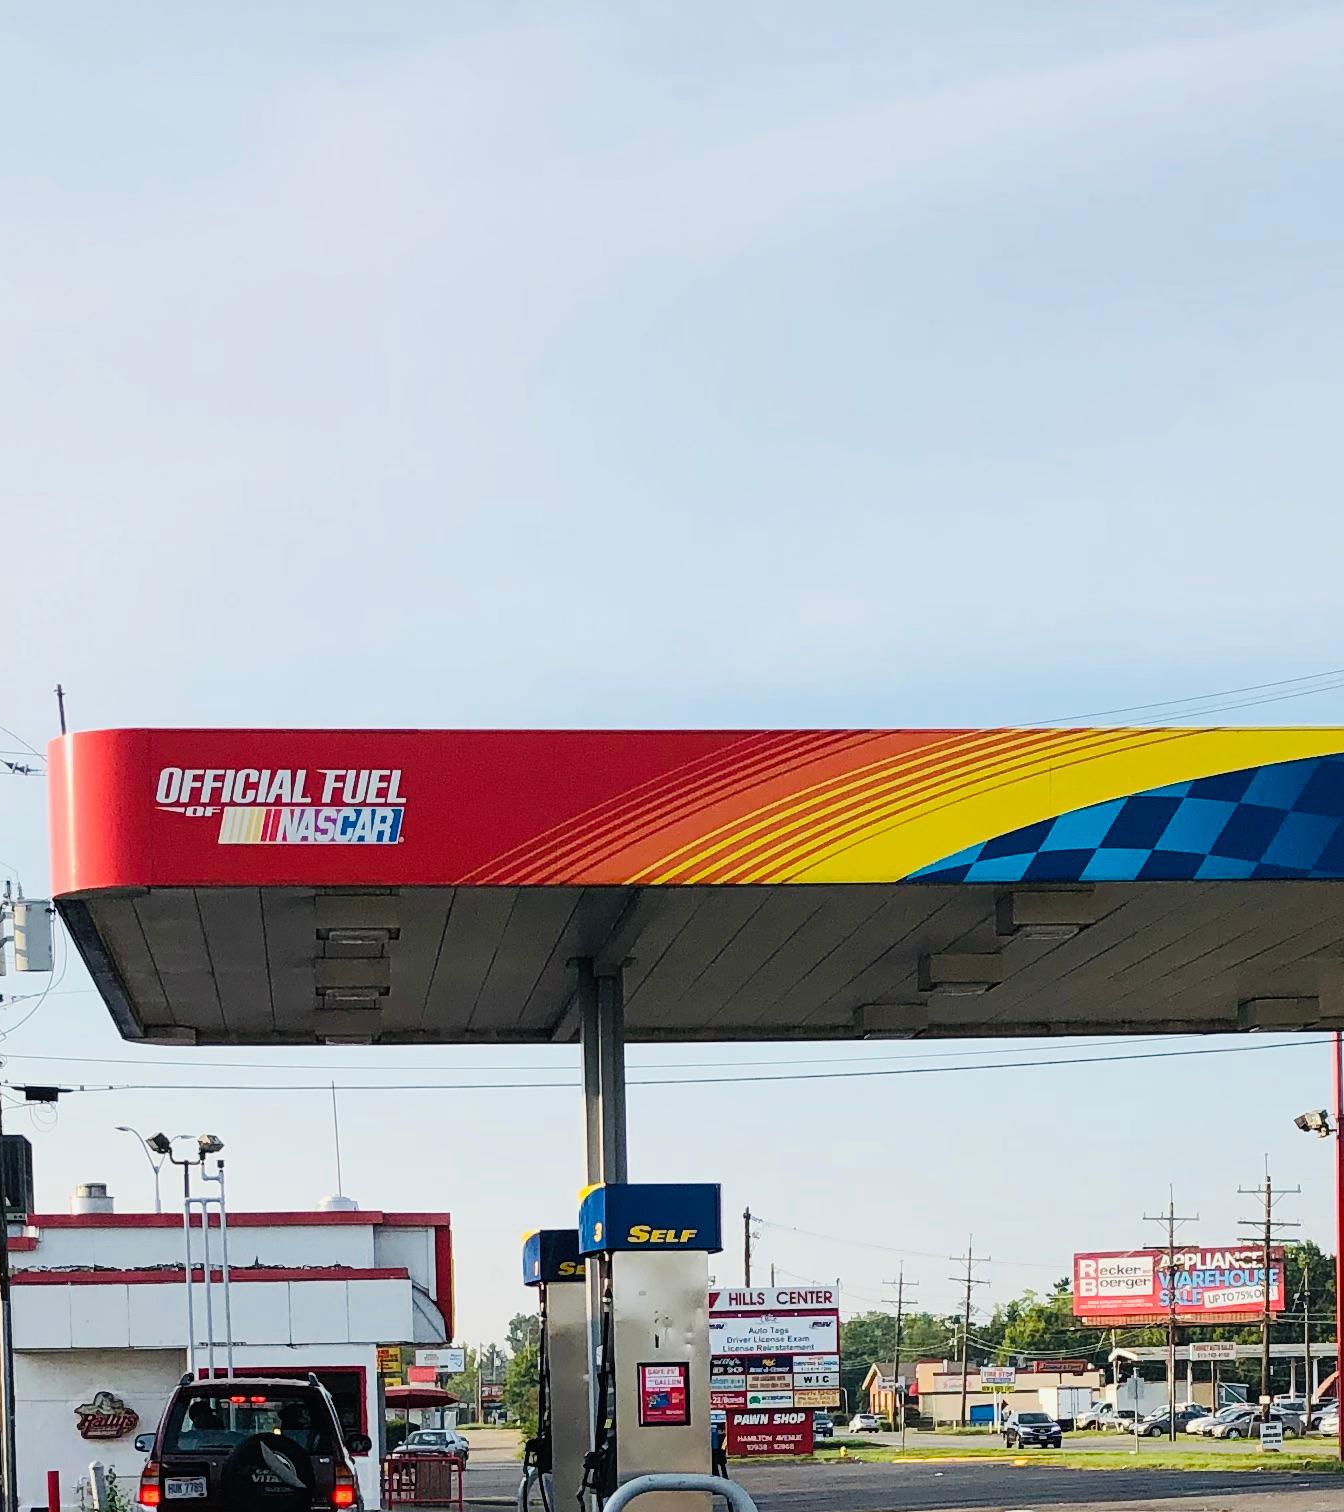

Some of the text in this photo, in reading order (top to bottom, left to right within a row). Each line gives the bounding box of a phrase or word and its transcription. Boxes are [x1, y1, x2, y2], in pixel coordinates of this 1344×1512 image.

[156, 767, 407, 804] OFFICIAL FUEL
[276, 807, 394, 842] NASCAR
[593, 1222, 603, 1243] 3
[626, 1224, 698, 1244] SELF
[557, 1261, 586, 1276] SE
[1158, 1251, 1264, 1271] APPLIANCE
[1158, 1268, 1280, 1289] WAREHOUSE
[728, 1291, 766, 1307] HILLS
[776, 1290, 833, 1306] CENTER
[1158, 1288, 1204, 1307] SALE
[1207, 1295, 1221, 1304] UP
[1221, 1293, 1234, 1302] TO
[1235, 1290, 1254, 1301] 75%
[748, 1326, 790, 1336] Auto Tags
[726, 1335, 810, 1344] Driver License Exam
[722, 1343, 815, 1353] License Reinstatement
[733, 1412, 806, 1426] PAWN SHOP
[737, 1433, 804, 1442] HAMILTON AVENUE
[251, 1473, 283, 1483] VITA
